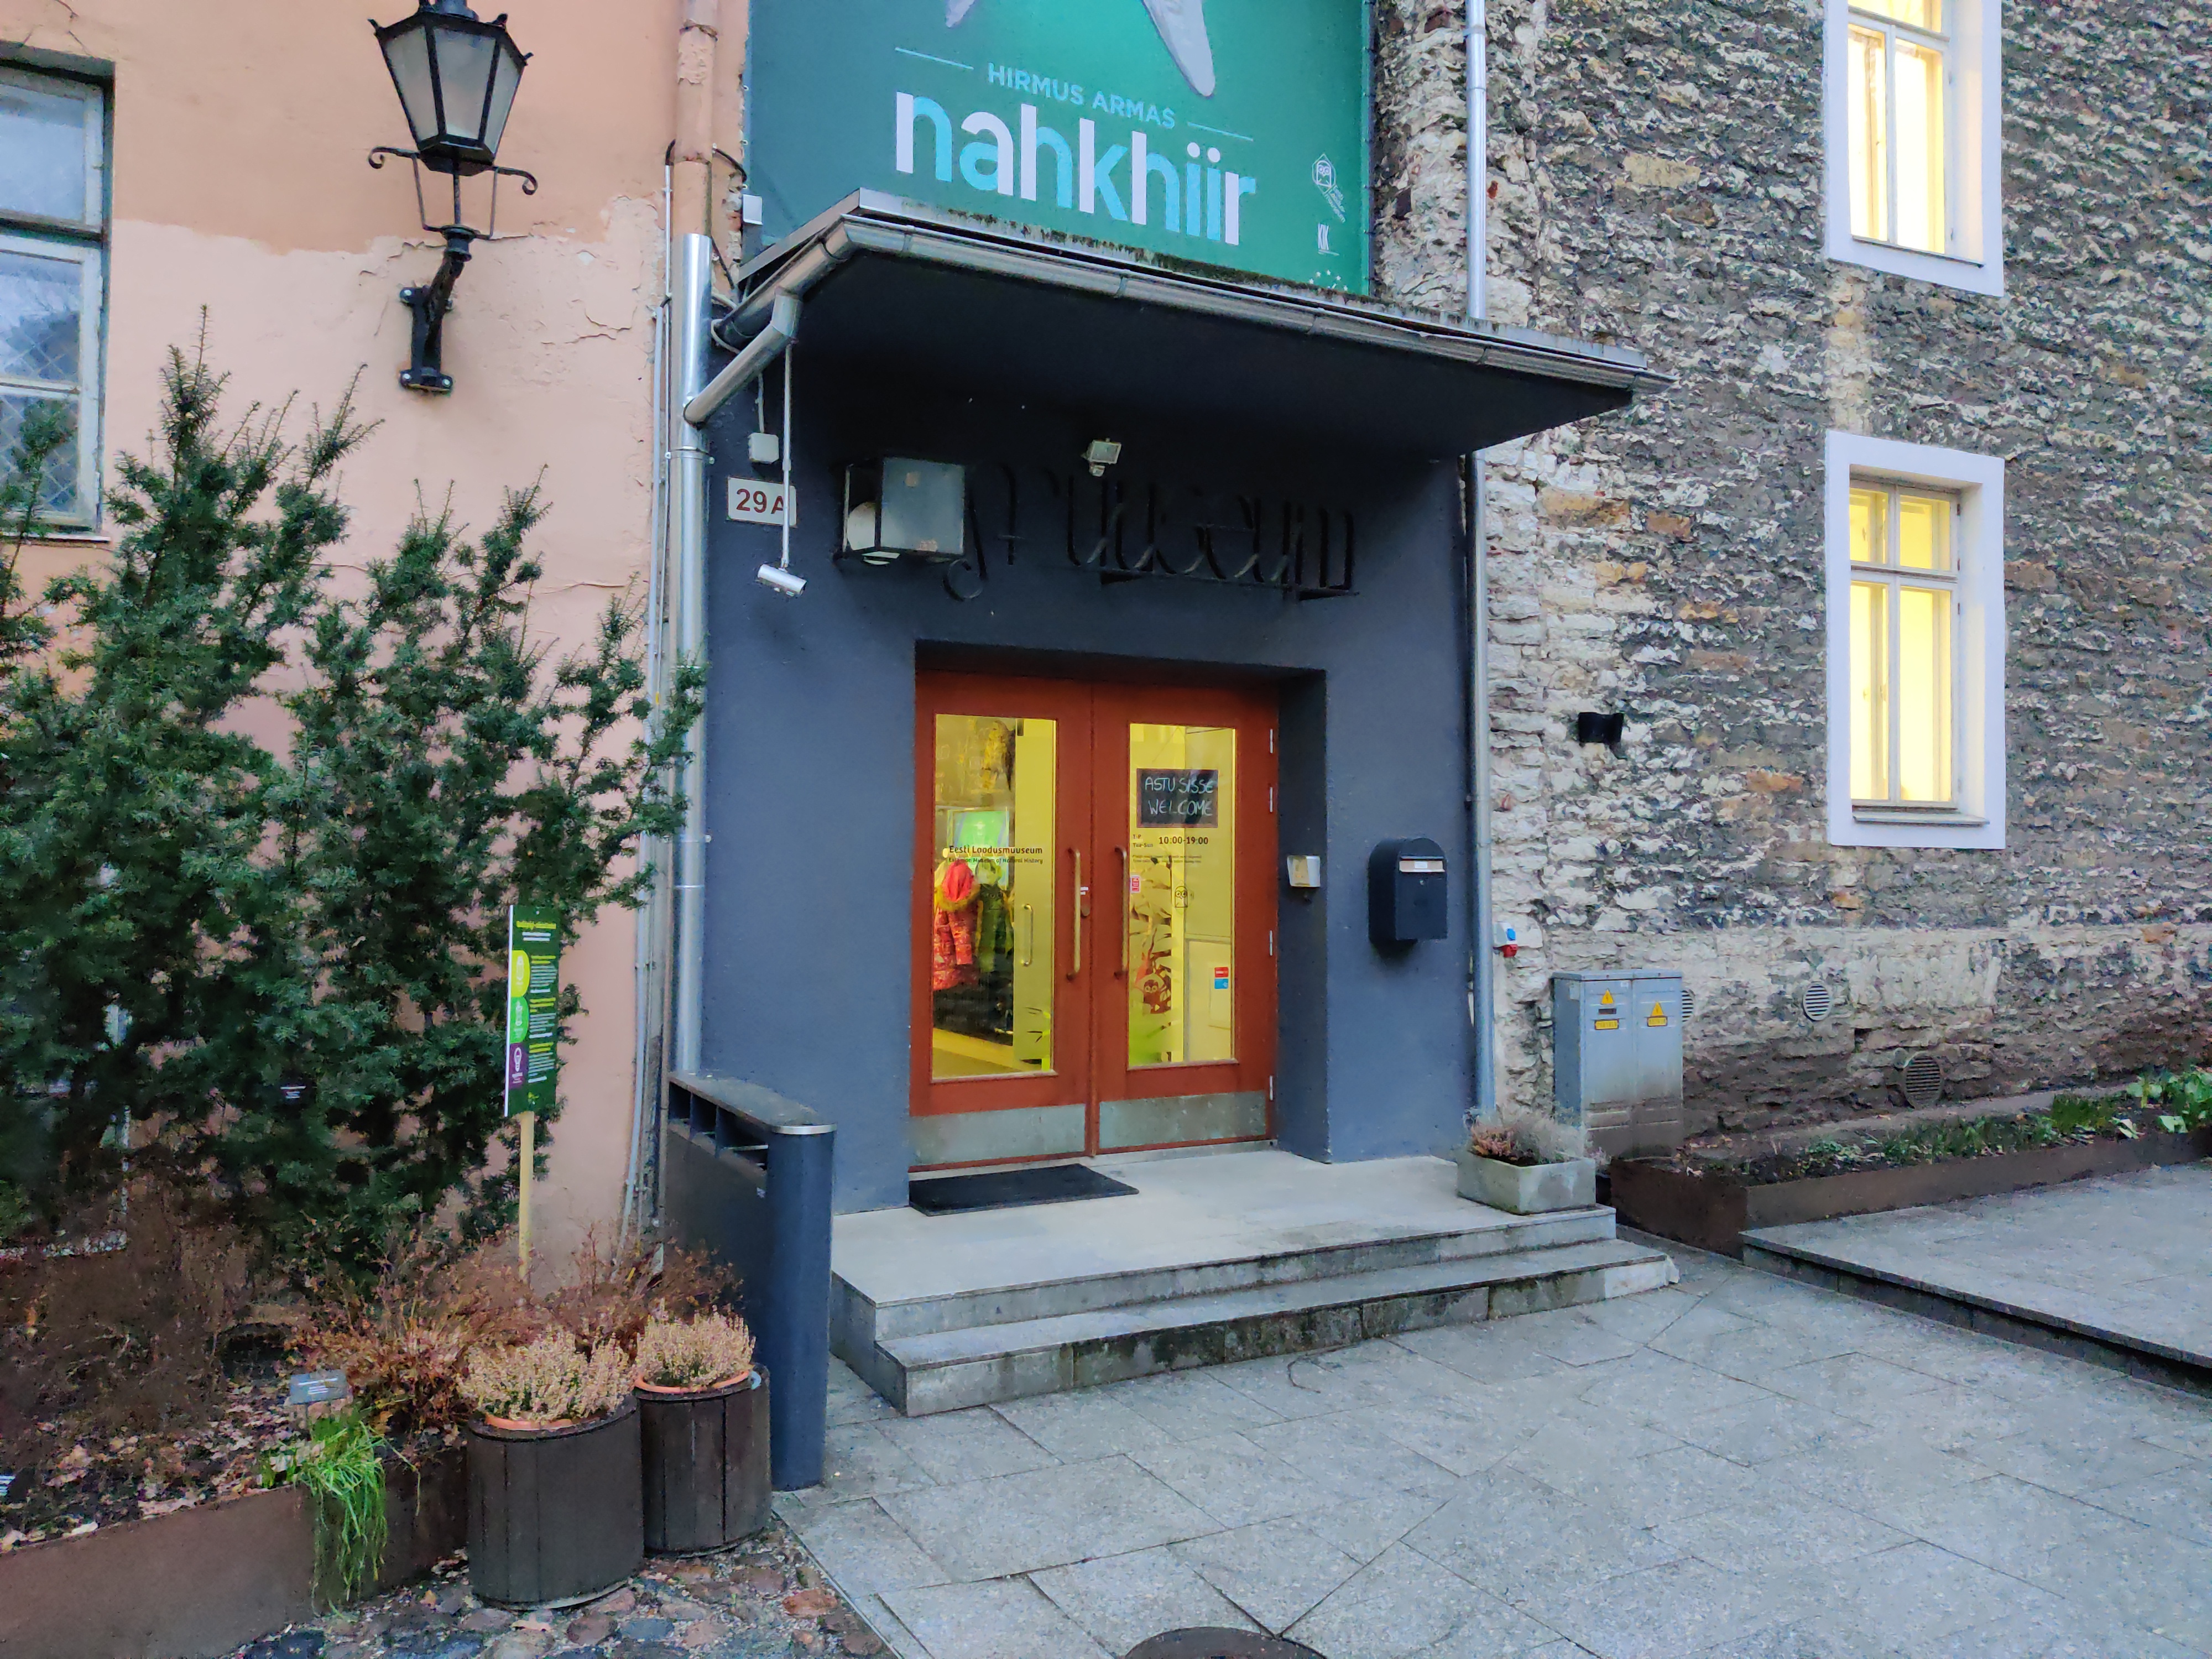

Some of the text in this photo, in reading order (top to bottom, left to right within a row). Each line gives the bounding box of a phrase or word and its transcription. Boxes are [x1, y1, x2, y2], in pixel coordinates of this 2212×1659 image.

[988, 62, 1176, 129] HIRMUS ARMAS
[895, 91, 1256, 246] nahkhiir
[736, 488, 785, 514] 29A
[1144, 776, 1214, 794] ASTU SISSE
[1148, 799, 1213, 816] WELCOME
[949, 845, 1043, 854] Eesti Loodusmuuseum
